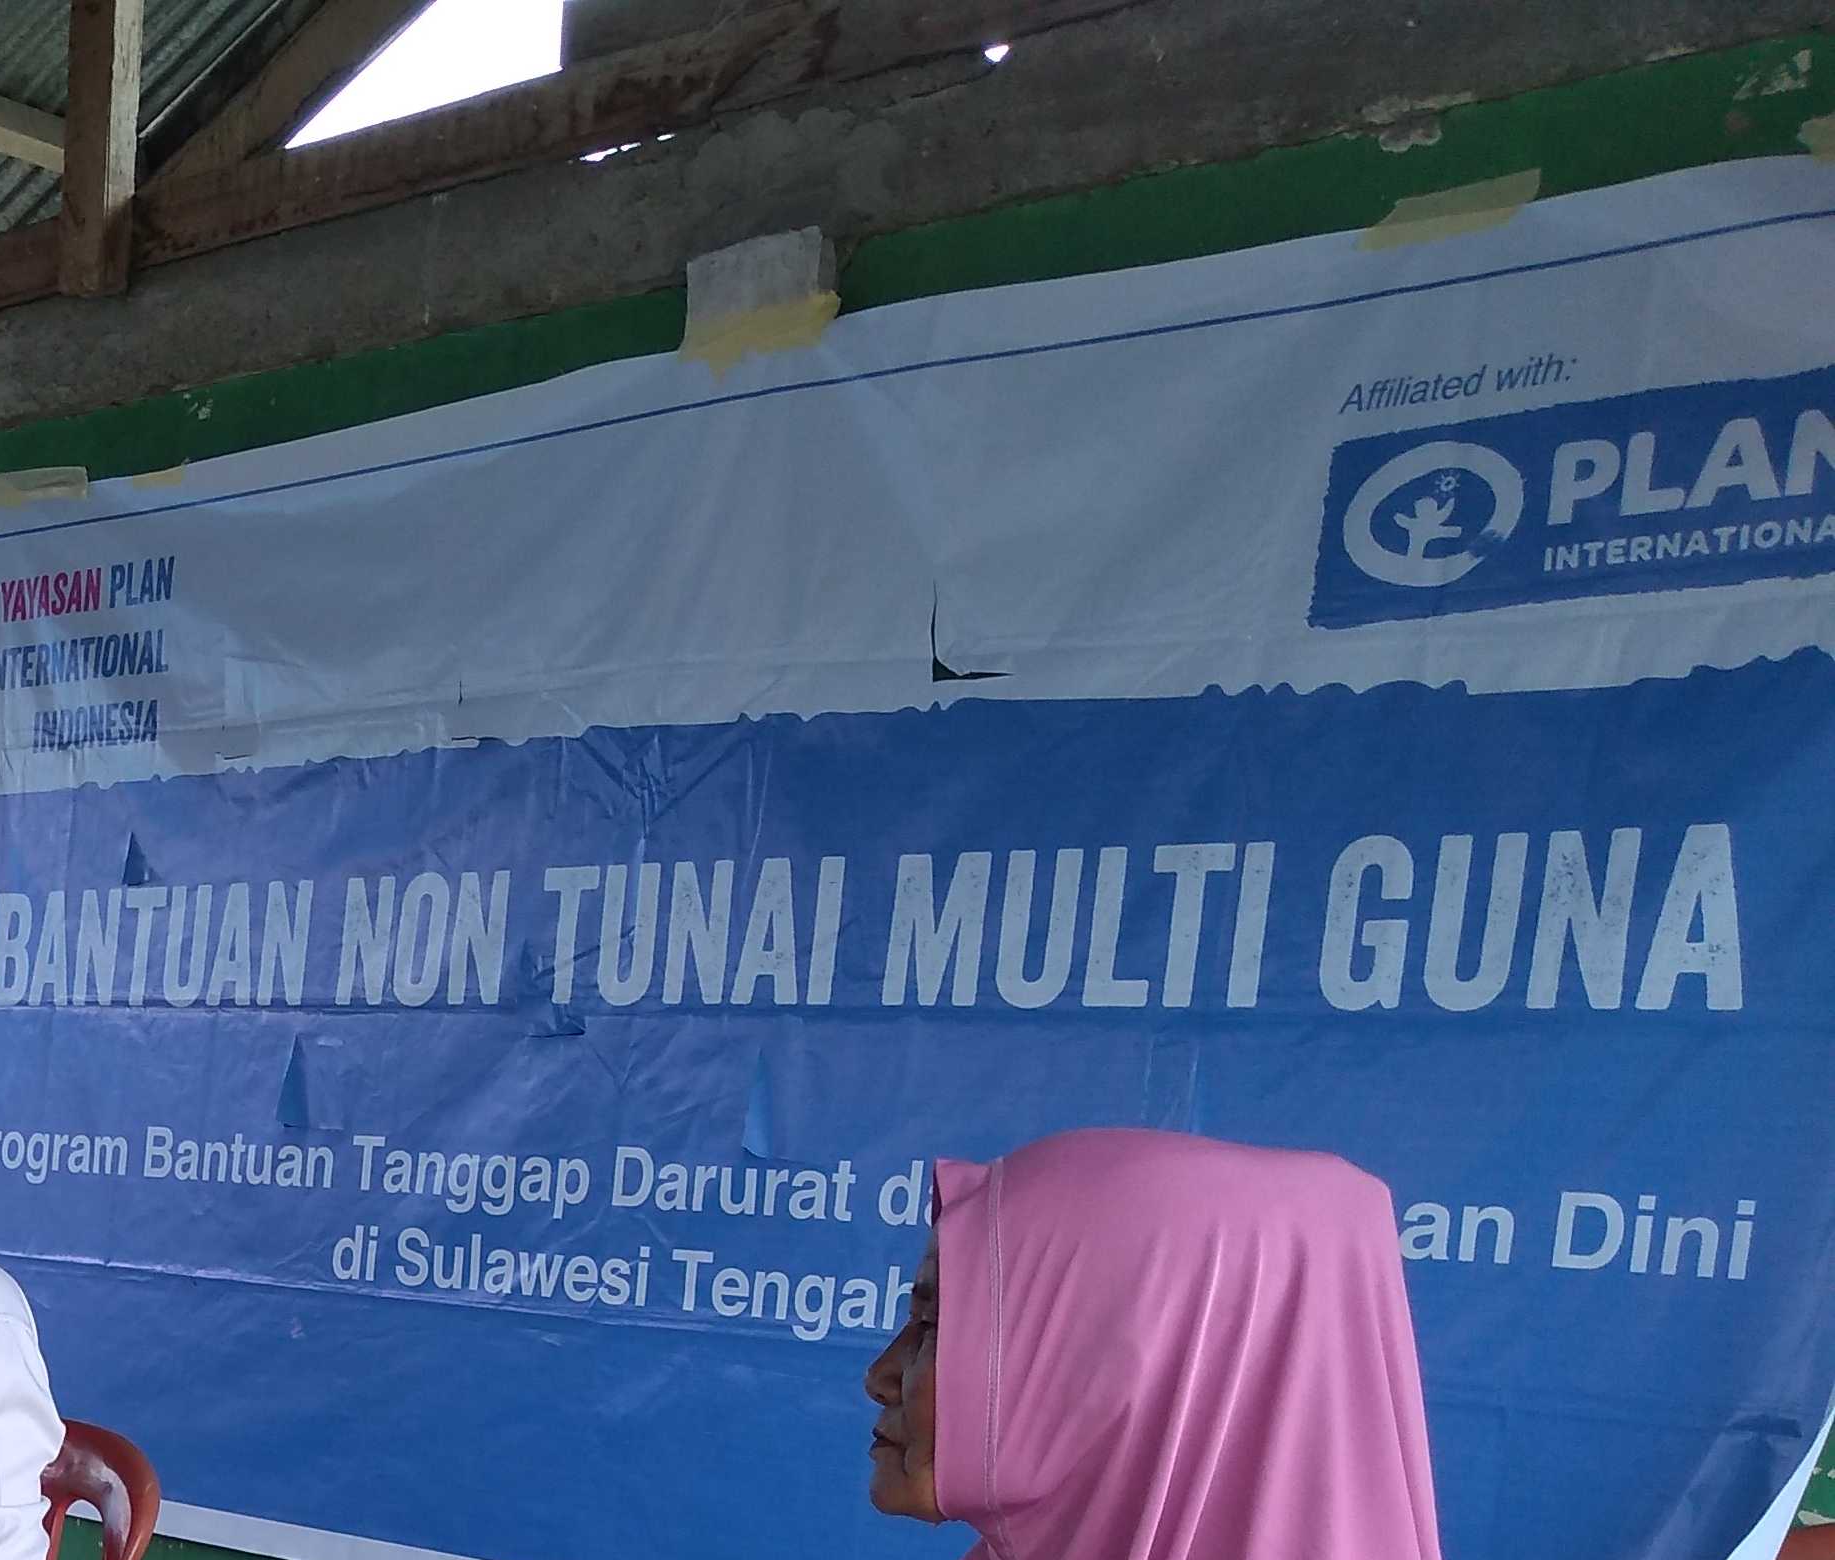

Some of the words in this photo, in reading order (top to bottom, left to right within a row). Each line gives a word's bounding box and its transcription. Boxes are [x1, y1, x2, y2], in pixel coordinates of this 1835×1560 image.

[1338, 363, 1488, 415] Affiliated
[1495, 352, 1577, 392] with:
[0, 567, 102, 623] YAYASAN
[109, 556, 175, 608] PLAN
[32, 699, 158, 754] INDONESIA
[335, 870, 510, 1006] NON
[544, 855, 847, 1006] TUNAI
[881, 840, 1276, 1010] MULTI
[1318, 823, 1744, 1012] GUNA
[143, 1125, 335, 1189] Bantuan
[353, 1134, 591, 1219] Tanggap
[611, 1145, 856, 1222] Darurat
[1552, 1190, 1757, 1281] Dini
[331, 1225, 379, 1282] di
[395, 1226, 650, 1308] Sulawesi
